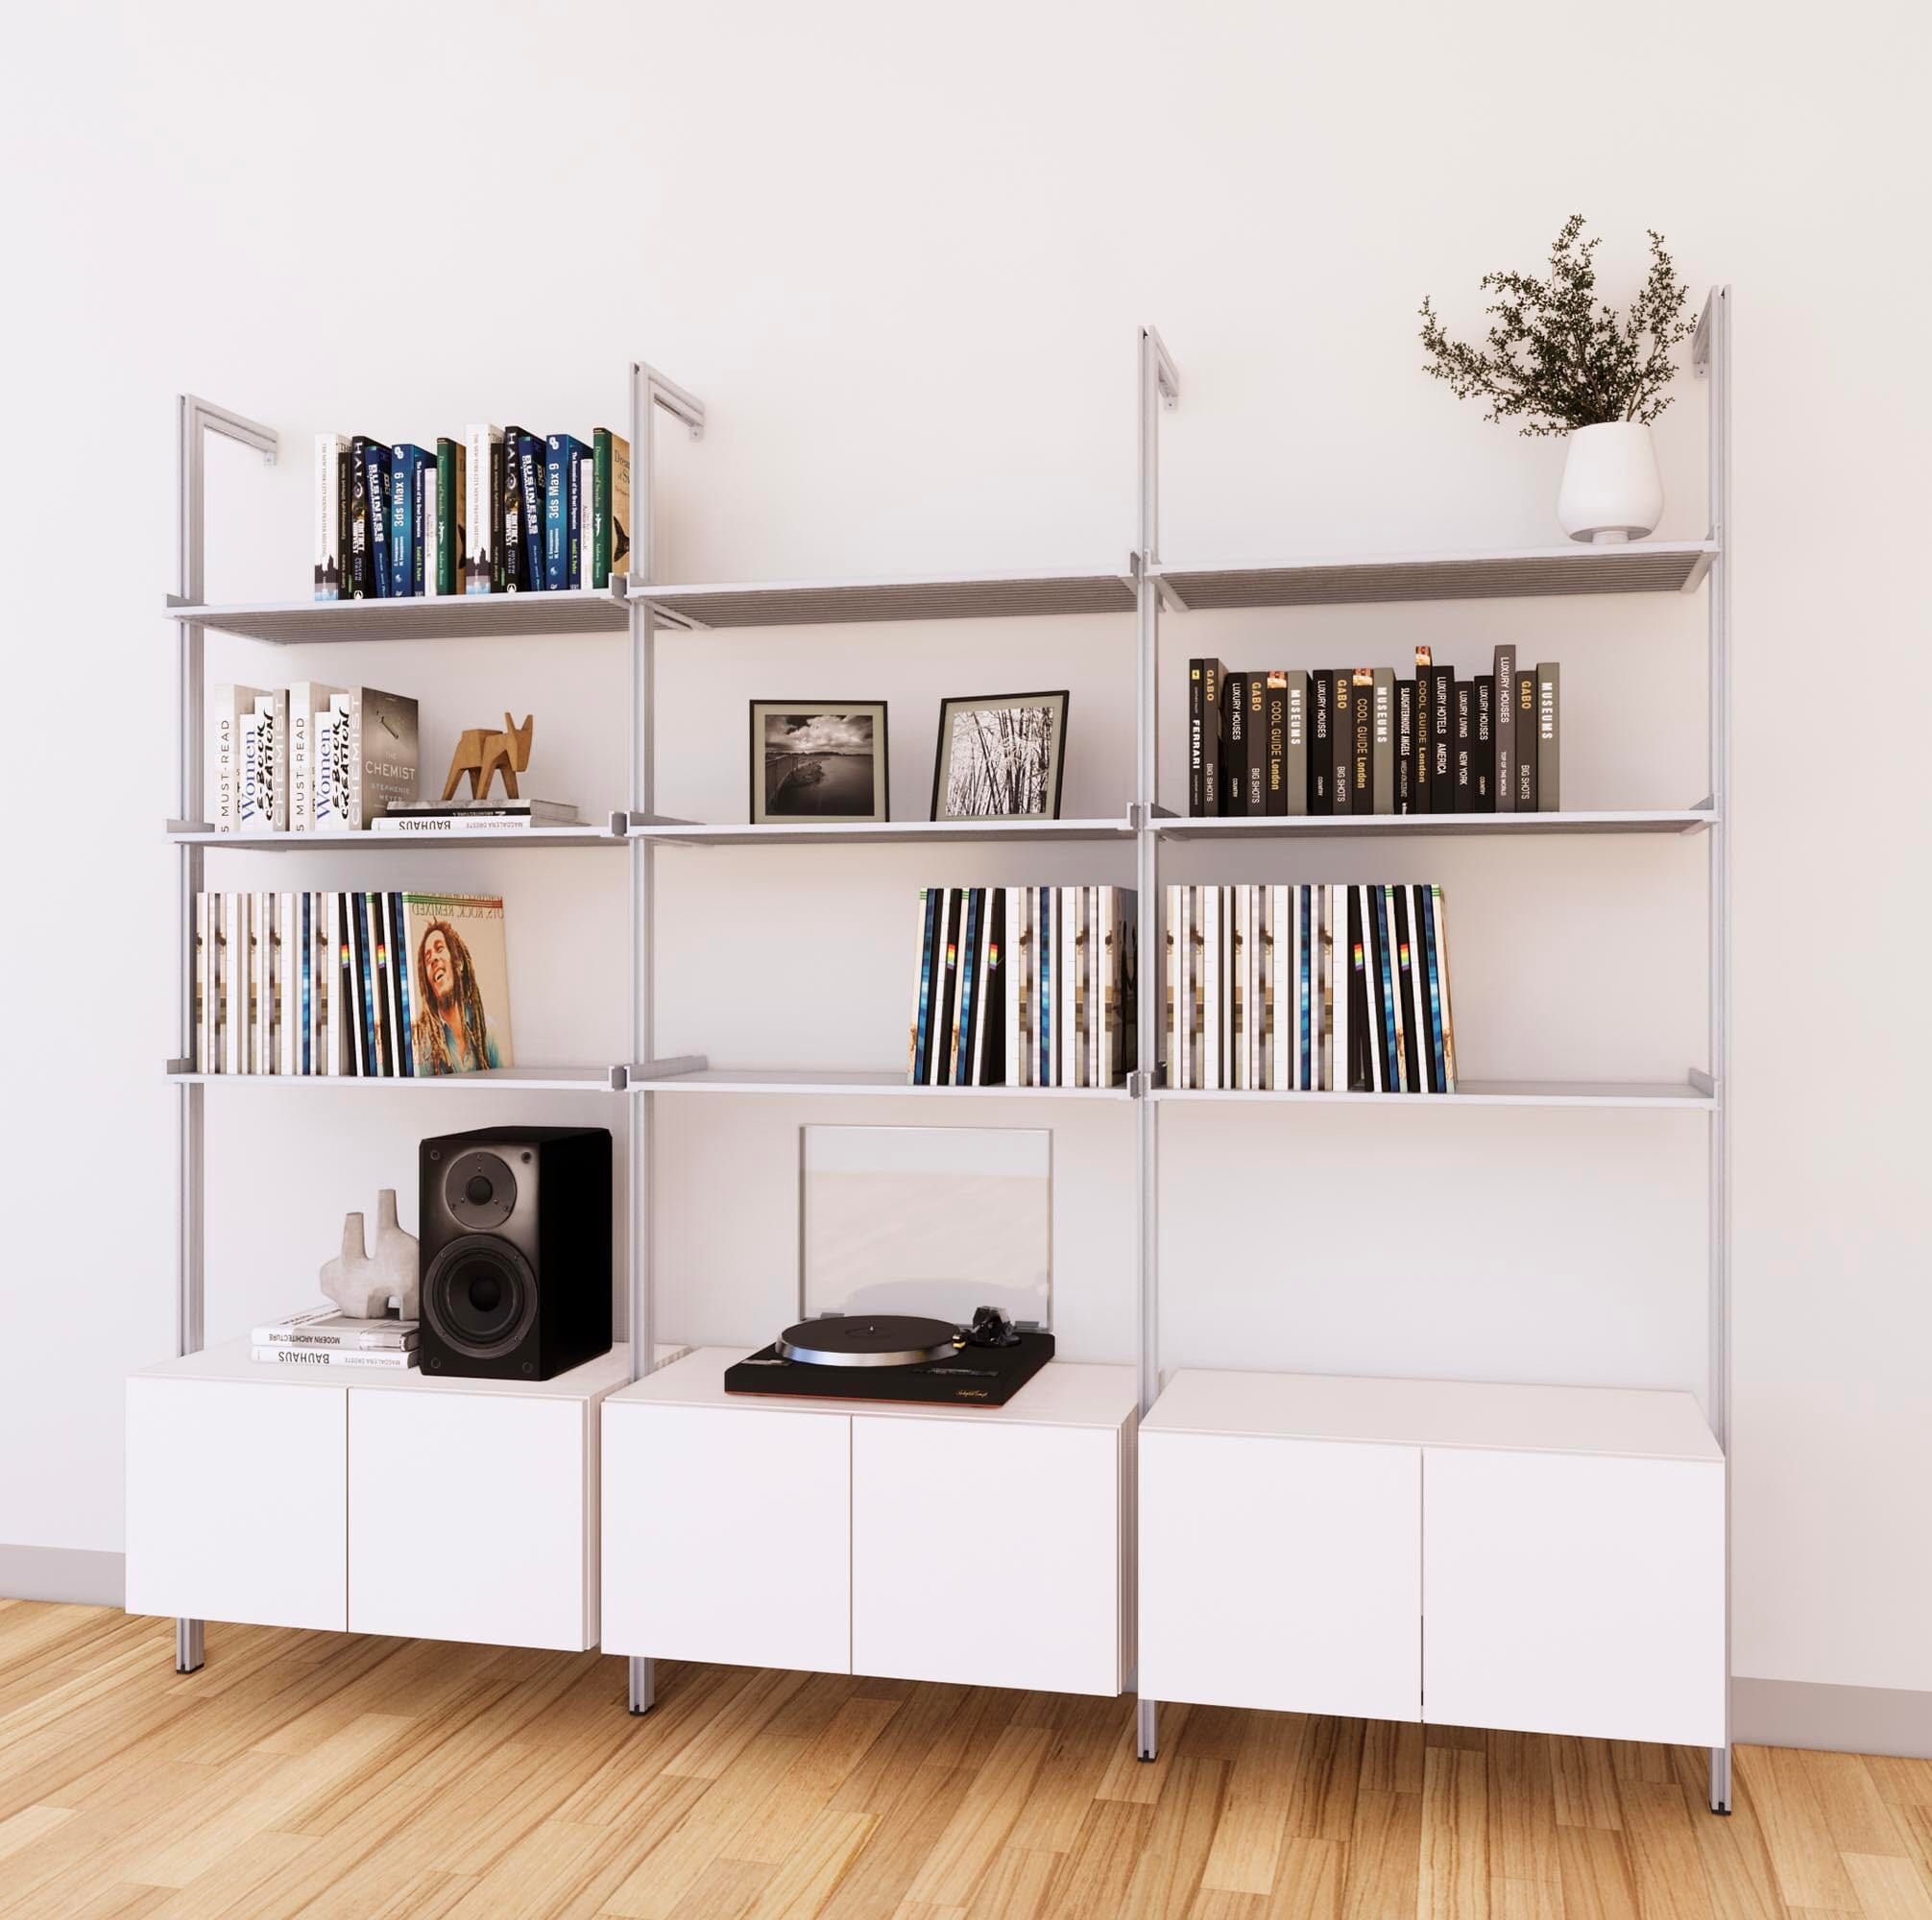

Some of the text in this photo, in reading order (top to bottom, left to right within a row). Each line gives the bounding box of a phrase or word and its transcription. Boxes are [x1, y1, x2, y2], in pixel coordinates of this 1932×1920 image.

[353, 442, 364, 498] HALO
[506, 432, 517, 490] HALO
[549, 473, 559, 495] Max
[373, 464, 384, 542] BUSINESS
[394, 482, 404, 504] Max
[394, 508, 404, 527] 3ds
[527, 455, 539, 535] BUSINESS
[549, 499, 559, 518] 3ds
[1232, 683, 1241, 740] LUXURY HOUSES
[1252, 683, 1261, 711] GABO
[1271, 701, 1281, 726] COOL
[1292, 690, 1301, 745] MUSEUMS
[1317, 681, 1326, 738] LUXURY HOUSES
[1338, 680, 1347, 709] GABO
[1358, 699, 1367, 724] COOL
[1377, 687, 1388, 743] MUSEUMS
[1401, 688, 1410, 735] SLAUGHTERHOUSE
[1418, 681, 1427, 708] COOL
[1480, 685, 1488, 740] LUXURY HOUSES
[1501, 657, 1509, 724] LUXURY HOUSES
[1521, 682, 1532, 709] GABO
[1542, 683, 1553, 739] MUSEUMS
[1271, 729, 1281, 756] GUIDE
[1358, 727, 1367, 754] GUIDE
[1401, 736, 1410, 756] ANGELS
[1418, 712, 1427, 743] GUIDE
[1437, 677, 1446, 775] LUXURY HOTELS AMERICA
[221, 720, 229, 816] MUST-READ
[241, 731, 255, 821] Women
[256, 723, 265, 809] E-BOOK
[264, 708, 274, 821] CREATION
[275, 699, 284, 827] CHEMIST
[296, 718, 304, 815] MUST-READ
[317, 730, 330, 820] Women
[332, 720, 342, 808] E-BOOK
[340, 707, 350, 820] CREATION
[350, 696, 360, 826] CHEMIST
[365, 761, 416, 780] CHEMIST
[1521, 765, 1530, 800] BIG SHOTS
[399, 820, 451, 829] BAUHAUS
[269, 1333, 313, 1344] ARCHITECTURE
[278, 1352, 329, 1364] BAUHAUS
